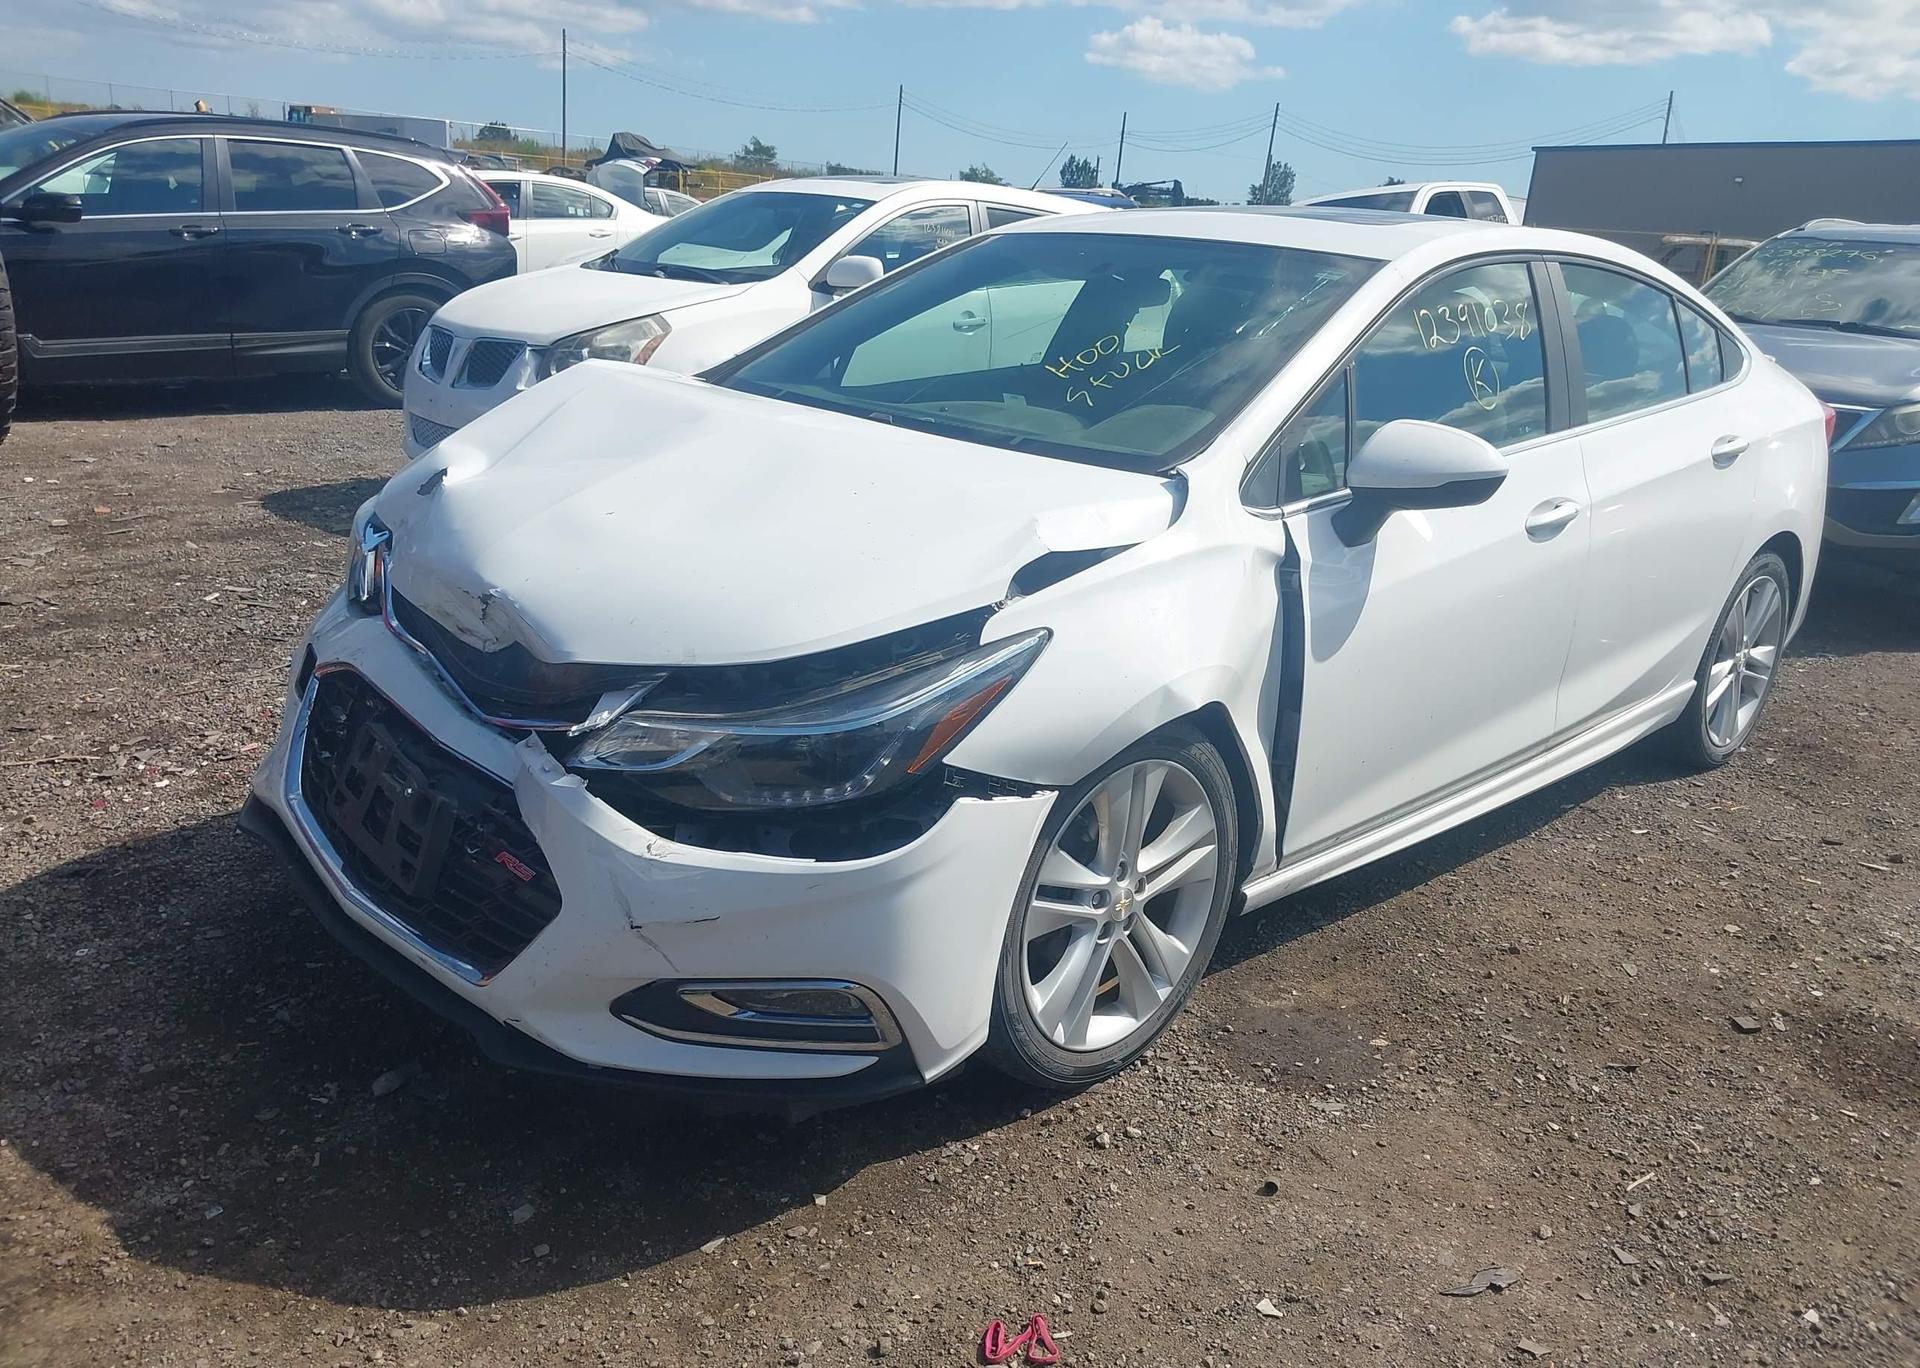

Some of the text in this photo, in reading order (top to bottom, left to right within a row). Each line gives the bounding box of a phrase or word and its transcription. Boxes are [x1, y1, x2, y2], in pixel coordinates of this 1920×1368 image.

[1413, 300, 1531, 349] 12391038
[1045, 335, 1121, 379] HOO
[495, 851, 536, 881] RS
